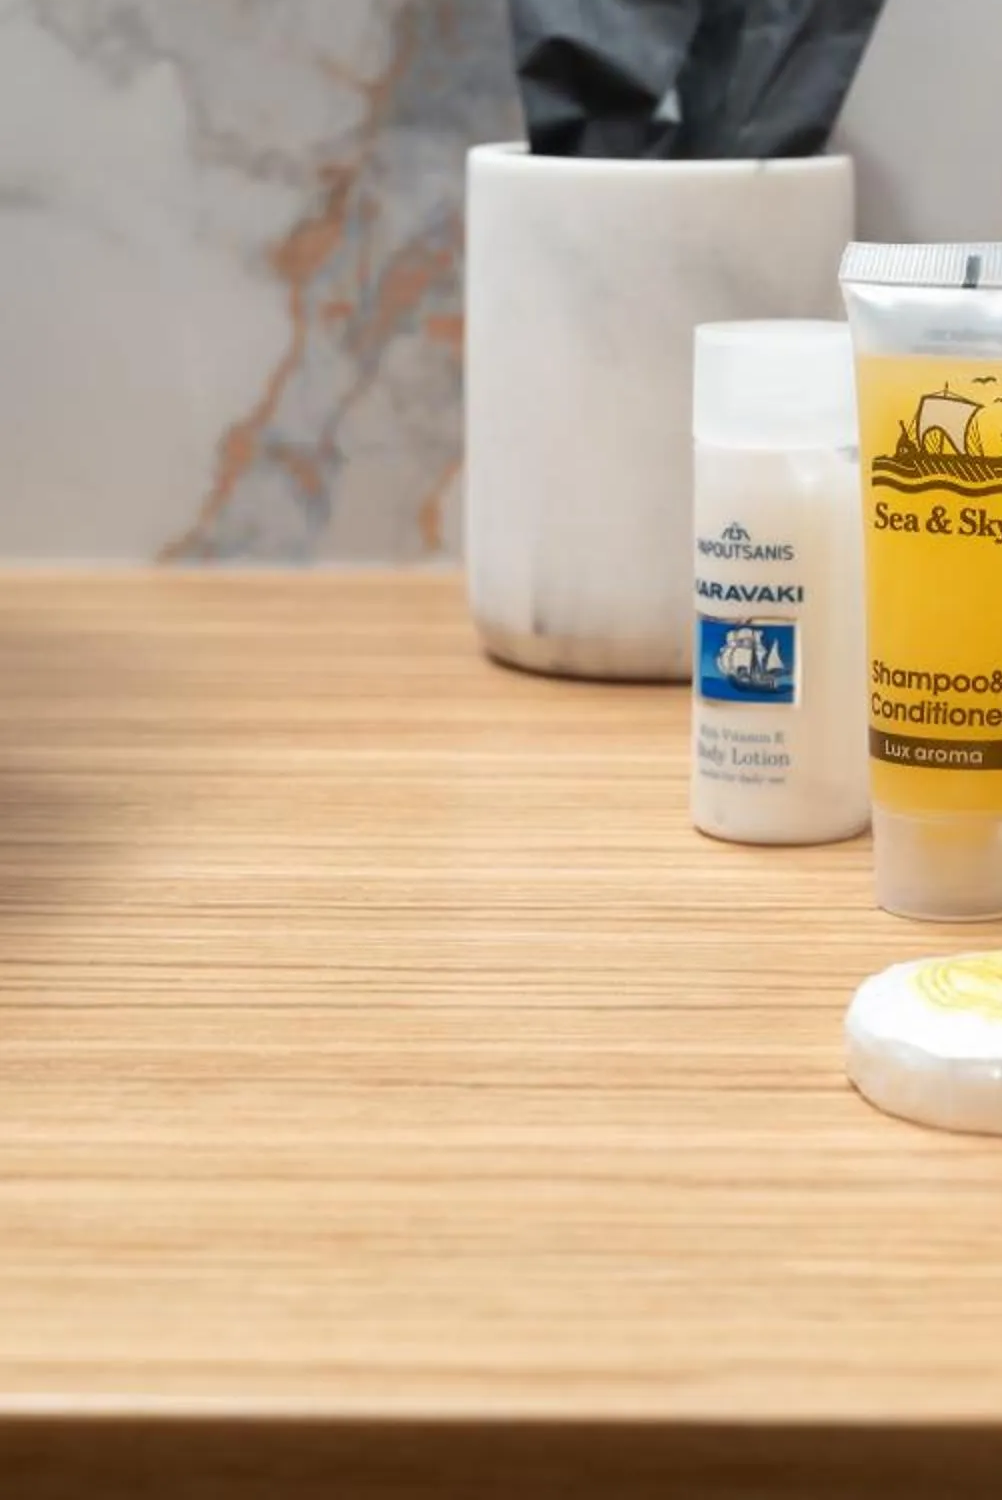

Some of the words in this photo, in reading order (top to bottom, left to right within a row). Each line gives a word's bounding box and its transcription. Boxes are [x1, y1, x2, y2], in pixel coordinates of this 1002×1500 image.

[874, 501, 920, 533] Sea
[925, 505, 953, 535] &
[731, 747, 790, 767] Lotion
[885, 740, 909, 757] Lux
[914, 744, 983, 765] aroma
